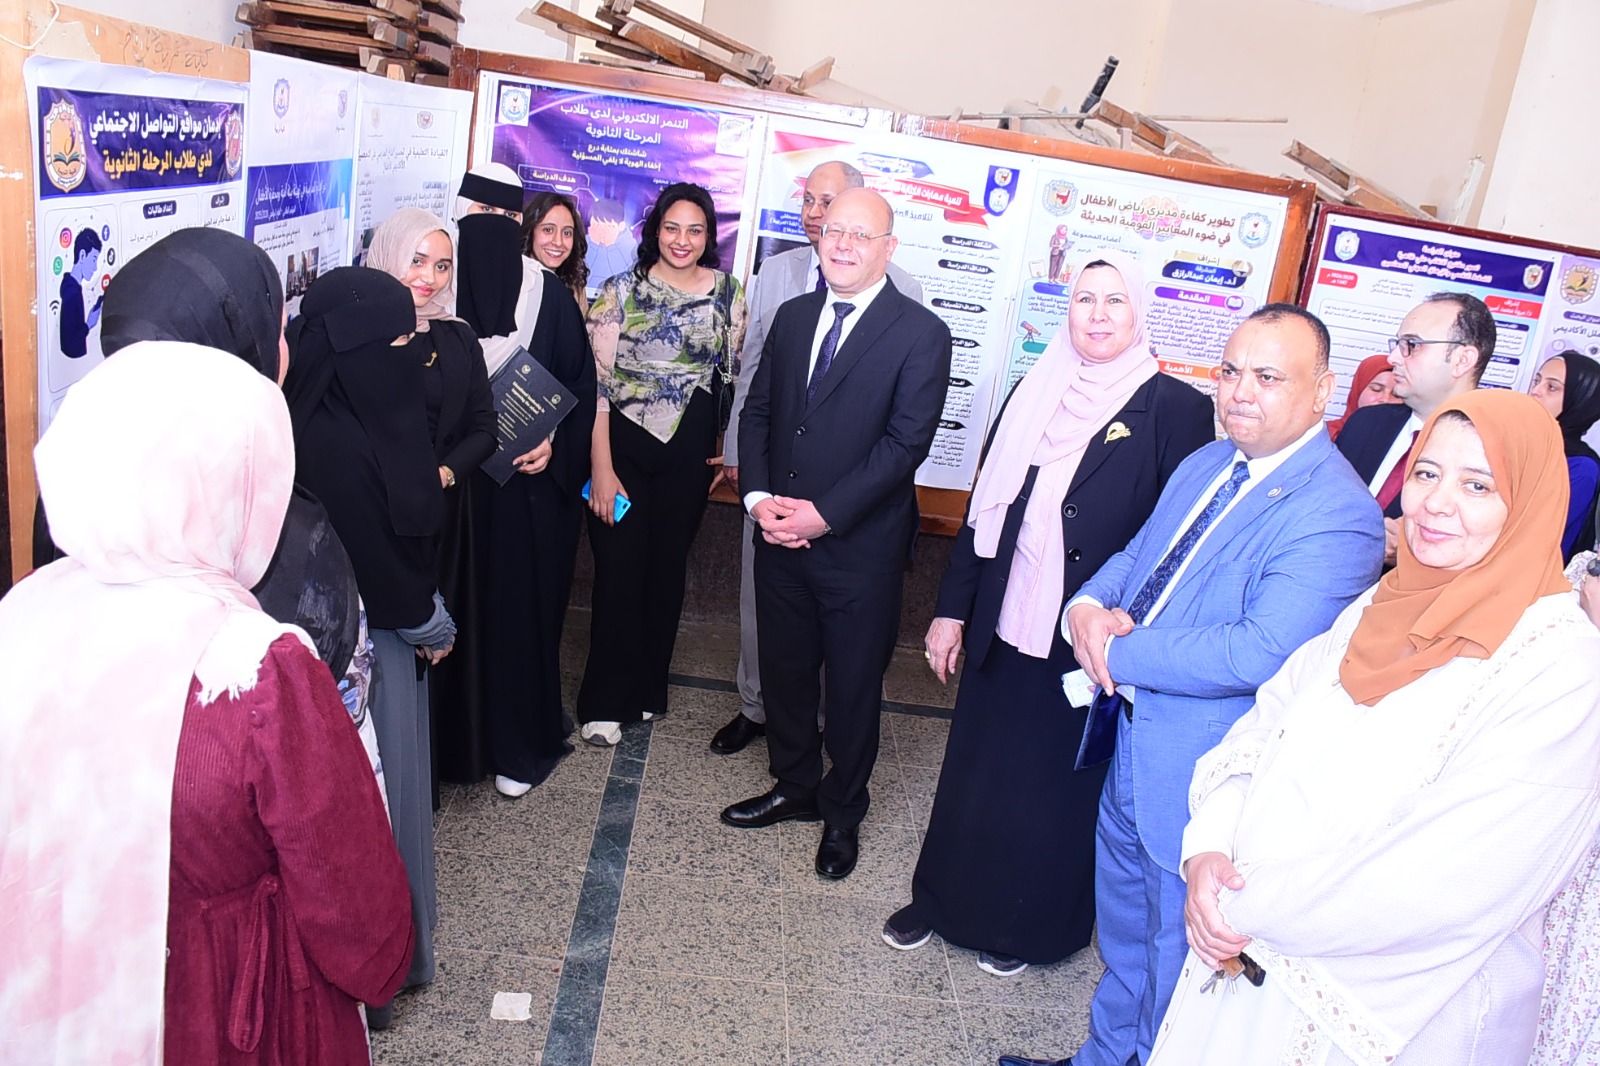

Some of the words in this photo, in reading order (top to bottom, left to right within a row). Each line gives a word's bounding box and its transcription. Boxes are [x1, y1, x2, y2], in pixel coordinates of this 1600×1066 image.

[560, 104, 588, 115] طلاب
[590, 108, 610, 119] لدى
[612, 111, 660, 125] الالكتروني
[660, 118, 688, 130] التنمر
[89, 110, 140, 145] الاجتماعي
[141, 112, 178, 139] التواصل
[179, 110, 202, 141] مواقع
[586, 122, 622, 138] الثانوية
[624, 128, 661, 144] المرحلة
[588, 144, 600, 153] درع
[103, 148, 140, 180] الثانوية
[142, 148, 172, 176] المرحلة
[174, 149, 196, 174] طلاب
[624, 158, 643, 168] الهوية
[532, 170, 559, 180] الدراسة
[559, 174, 576, 183] هدف
[920, 188, 943, 202] مهارات
[944, 193, 962, 206] تنمية
[1080, 193, 1116, 208] الأطفال
[1118, 200, 1146, 214] رياض
[1081, 210, 1117, 225] الحديثة
[1180, 210, 1207, 223] كفاءة
[1207, 215, 1236, 230] تطوير
[1120, 218, 1155, 230] القومية
[1156, 222, 1194, 237] المعايير
[1072, 230, 1102, 240] المجموعة
[1102, 234, 1121, 243] أعضاء
[1195, 230, 1216, 242] ضوء
[952, 237, 974, 248] الدراسة
[1217, 234, 1231, 249] في
[1198, 255, 1220, 266] إشراف
[1205, 275, 1224, 286] إيمان
[1178, 291, 1210, 303] المقدمة
[1504, 300, 1520, 308] إشراف
[1553, 325, 1587, 336] الأكاديمي
[1164, 362, 1193, 374] الأهمية
